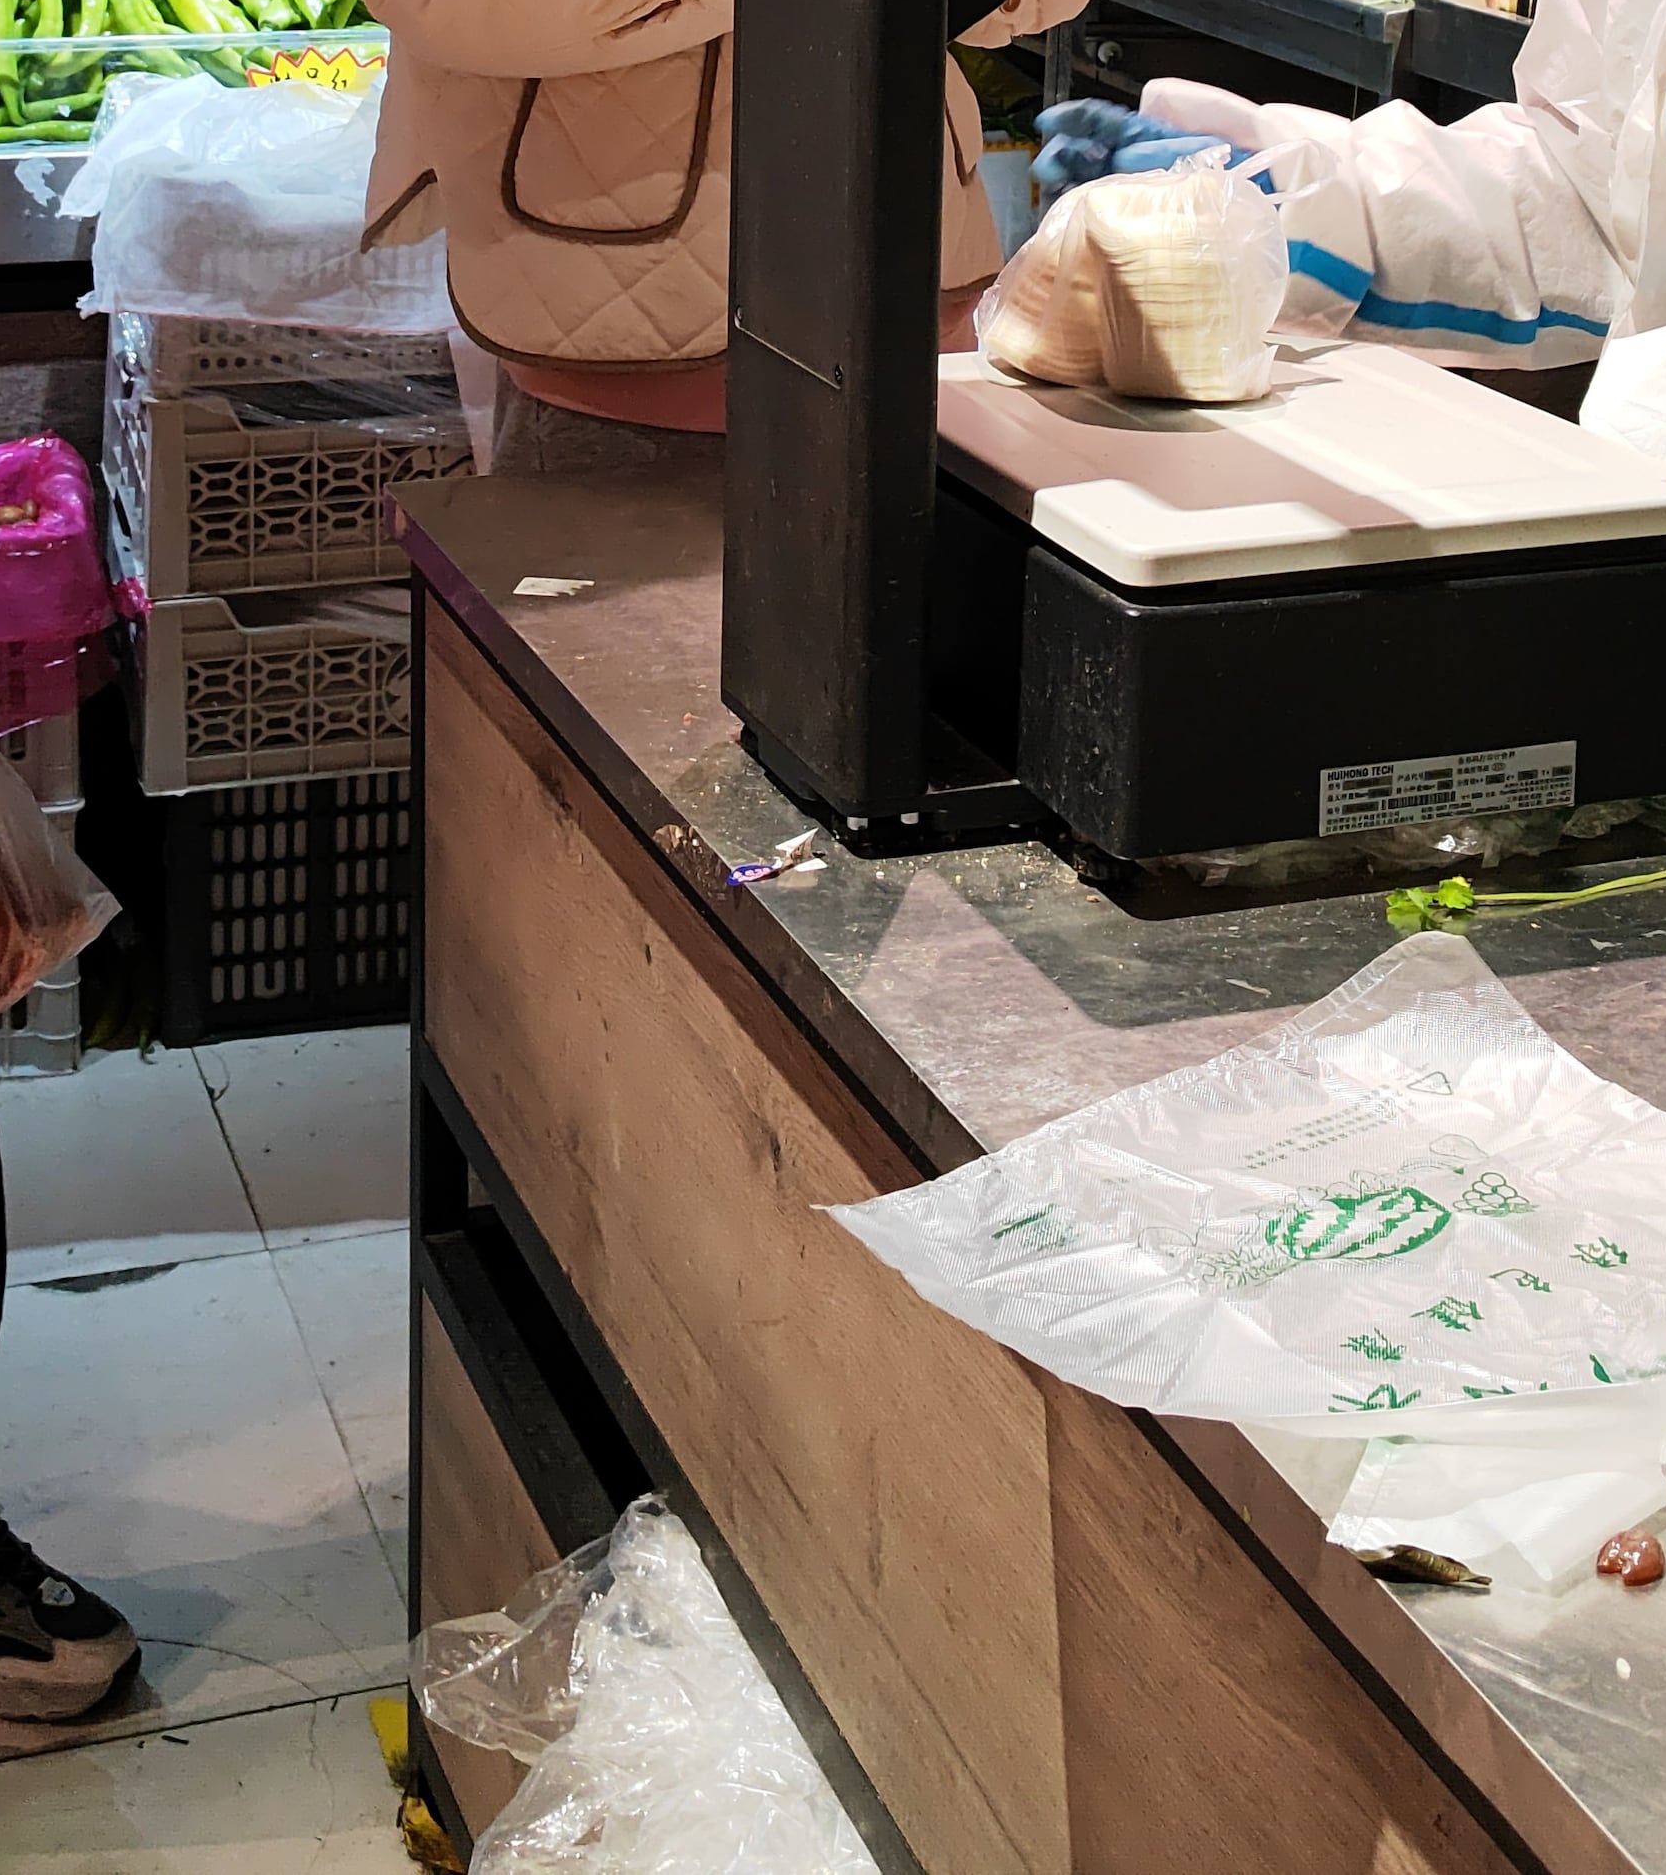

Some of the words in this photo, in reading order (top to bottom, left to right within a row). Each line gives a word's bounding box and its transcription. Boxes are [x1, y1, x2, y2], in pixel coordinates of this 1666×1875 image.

[1327, 767, 1369, 782] HUIHONG
[1371, 764, 1394, 777] TECH
[1339, 1235, 1628, 1362] 绿色健康
